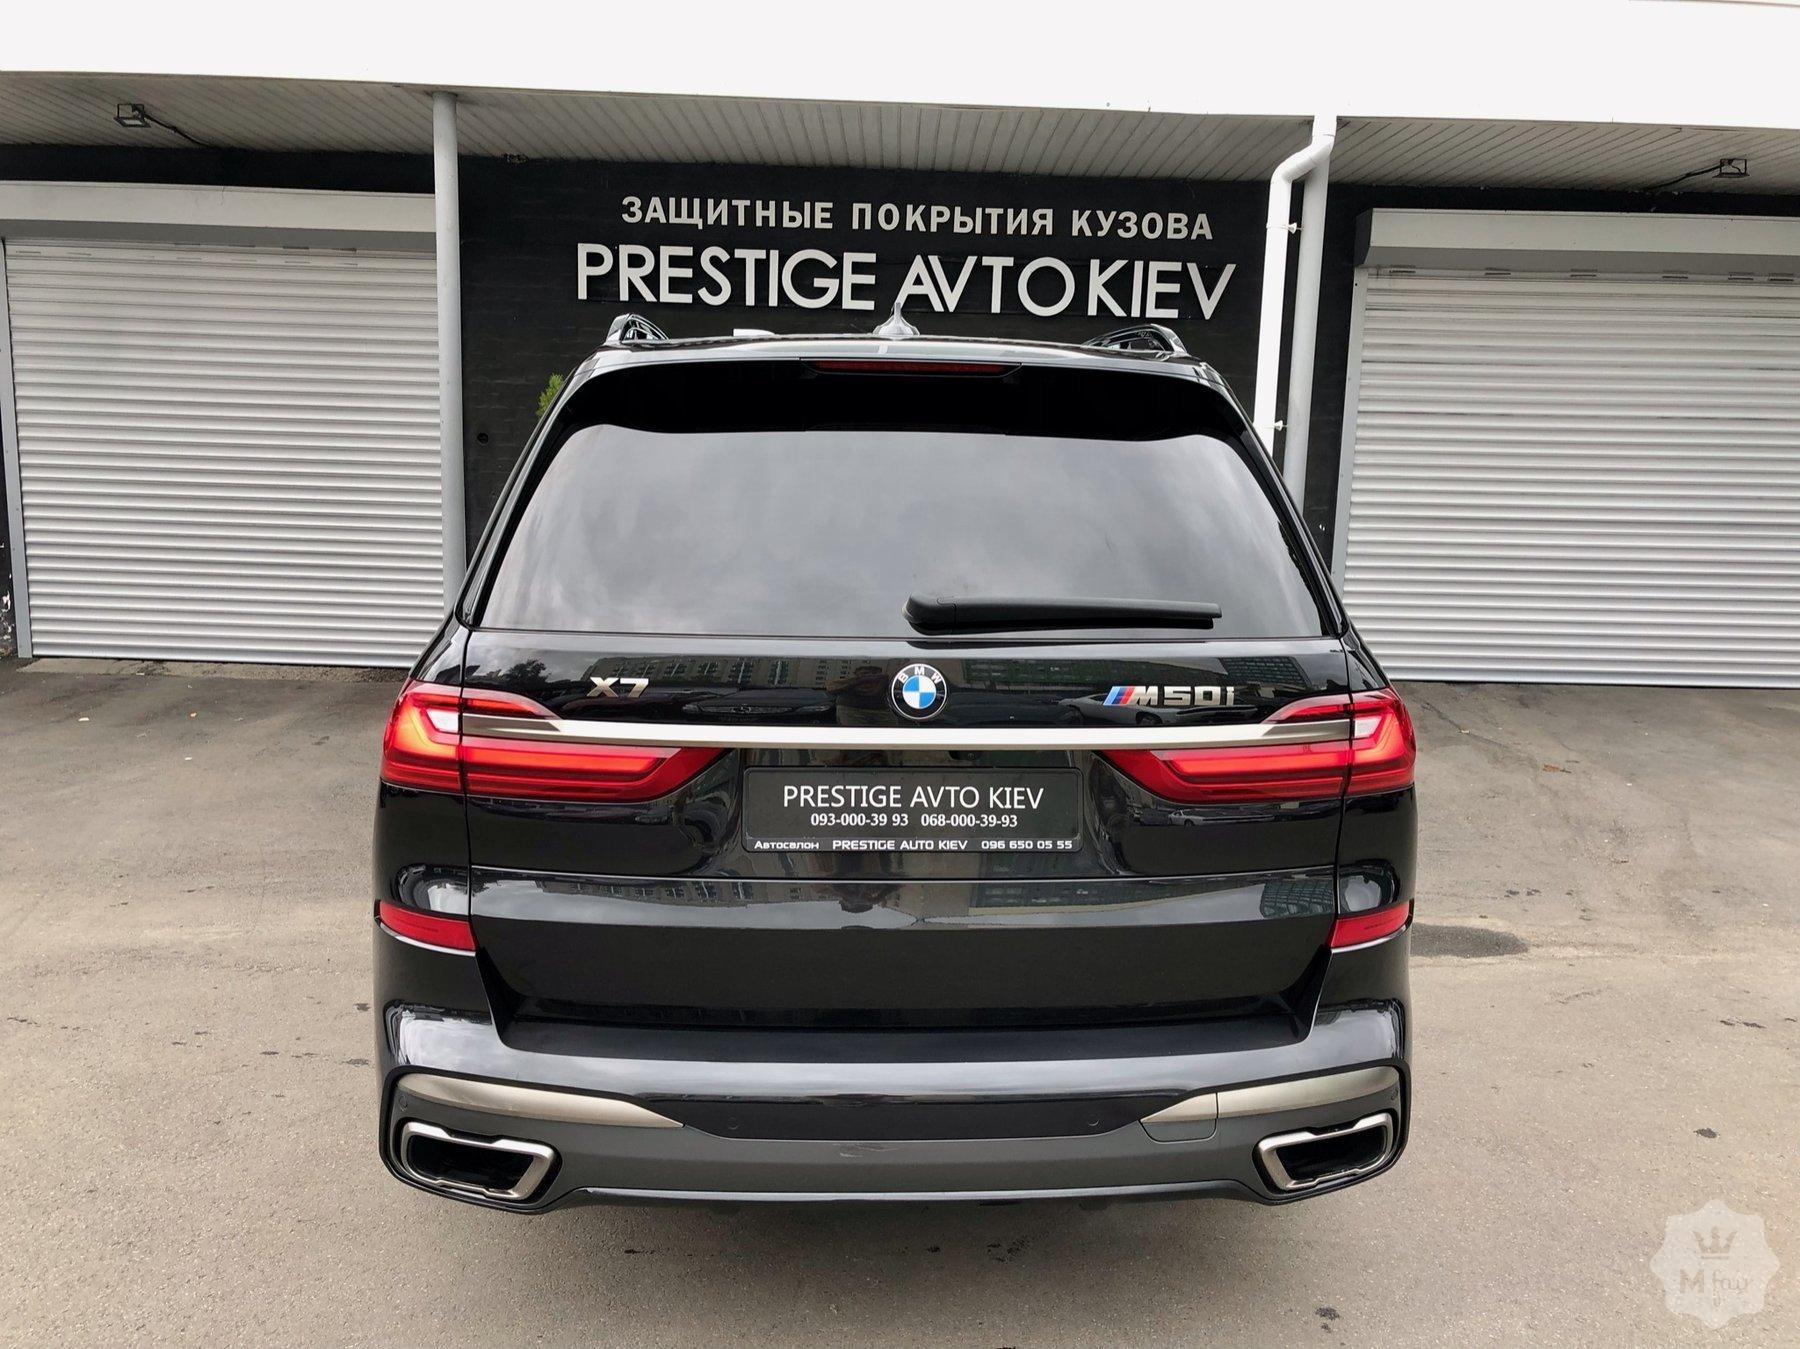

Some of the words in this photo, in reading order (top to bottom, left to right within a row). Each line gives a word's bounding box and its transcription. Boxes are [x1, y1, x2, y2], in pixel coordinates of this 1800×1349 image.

[621, 196, 834, 230] ЗАЩИТНЫЕ
[852, 202, 1053, 236] ПОКРЫТИЯ
[1071, 209, 1213, 240] КУЗОВА
[577, 243, 877, 311] PRESTIGE
[895, 255, 1075, 317] AVTO
[1087, 258, 1237, 320] KIEV
[897, 665, 942, 684] BMW
[586, 676, 649, 698] X7
[783, 785, 902, 808] PRESTIGE
[910, 786, 980, 809] AVTO
[989, 787, 1044, 810] KIEV
[810, 813, 888, 826] 093-000-39
[892, 813, 909, 826] 93
[920, 813, 1018, 828] 068-000-39-93
[754, 840, 820, 850] Автосалон
[832, 840, 896, 850] PRESTIGE
[900, 840, 934, 850] AUTO
[938, 840, 968, 850] KIEV
[981, 840, 1006, 850] 096
[1009, 840, 1033, 850] 650
[1036, 840, 1053, 850] 05
[1056, 840, 1073, 850] 55
